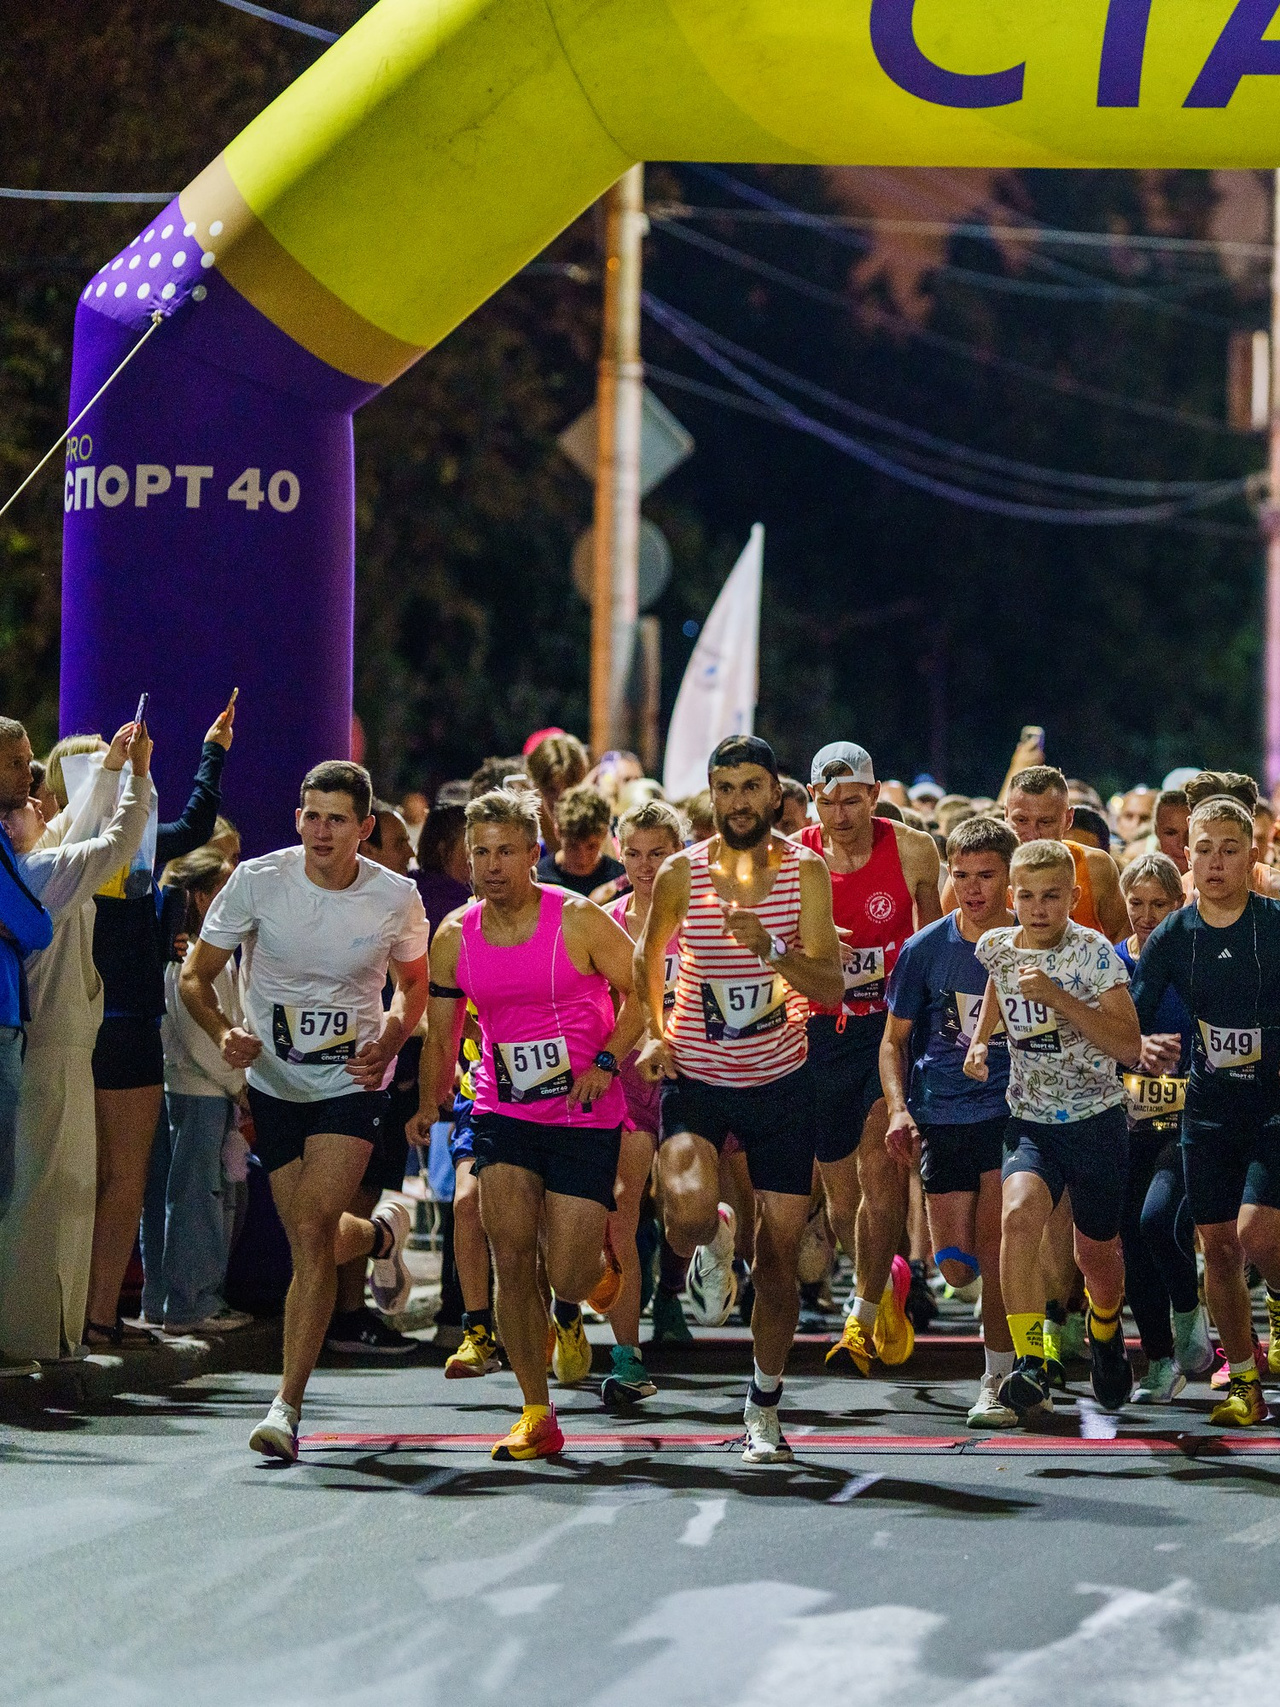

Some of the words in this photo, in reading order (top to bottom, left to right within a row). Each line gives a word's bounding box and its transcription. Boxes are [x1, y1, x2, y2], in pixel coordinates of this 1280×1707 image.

[66, 434, 93, 463] PRO
[64, 464, 214, 514] СПОРТ
[227, 467, 301, 513] 40
[843, 951, 877, 975] 34
[728, 980, 774, 1011] 577
[300, 1011, 348, 1036] 579
[1005, 998, 1048, 1024] 219
[1210, 1028, 1253, 1056] 549
[513, 1042, 560, 1073] 519
[1137, 1080, 1177, 1104] 199
